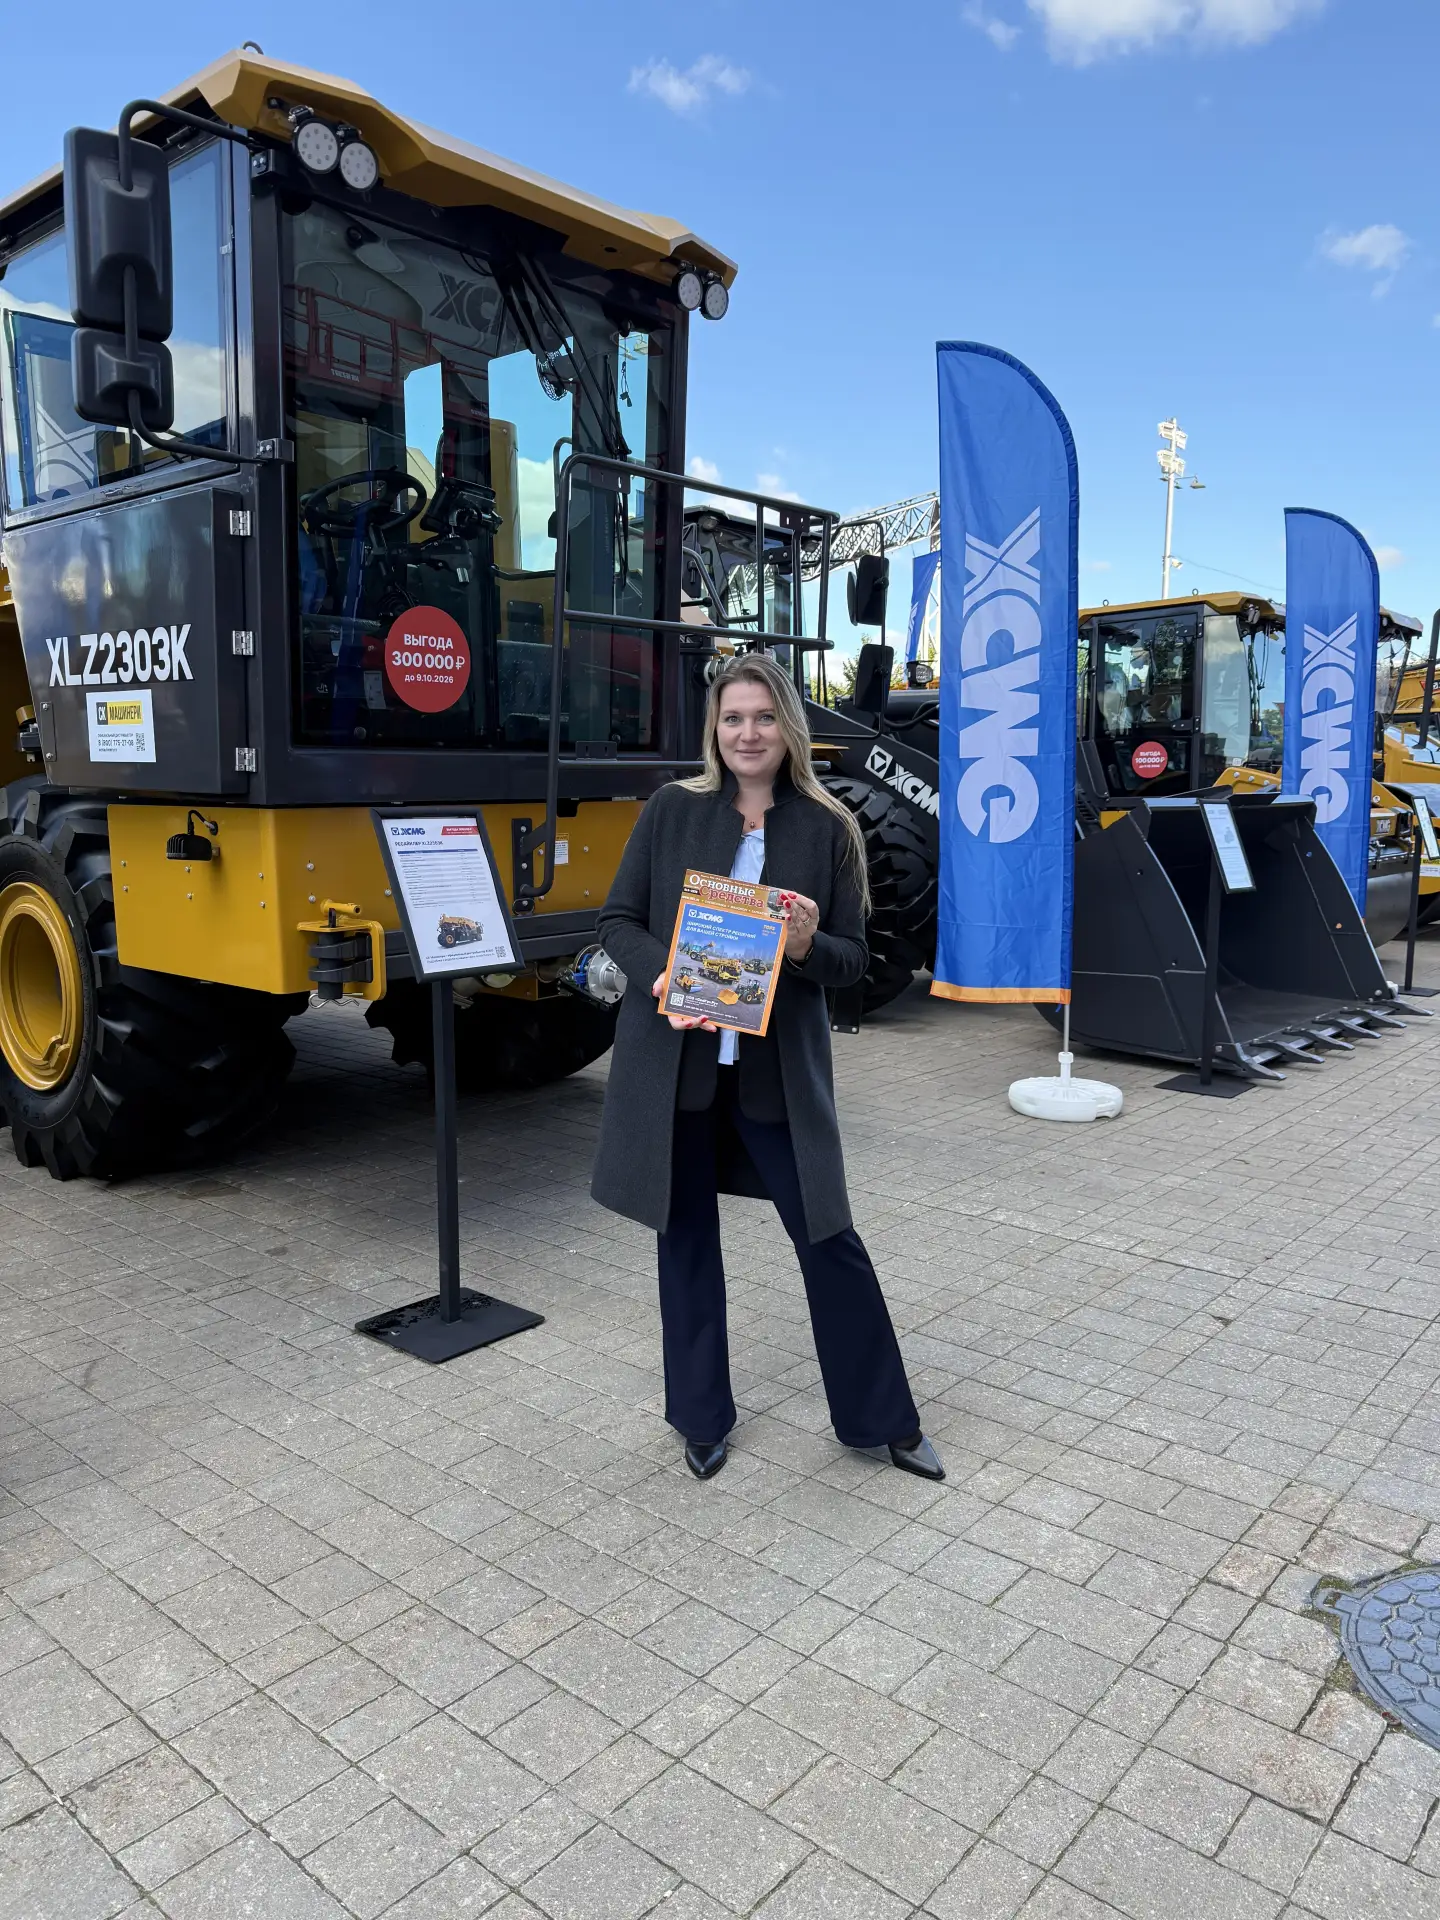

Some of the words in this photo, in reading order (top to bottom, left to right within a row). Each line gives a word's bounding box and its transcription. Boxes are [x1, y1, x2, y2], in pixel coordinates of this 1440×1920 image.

[403, 634, 454, 651] ВЫГОДА
[45, 623, 194, 687] XLZ2303K
[405, 674, 415, 682] до
[416, 674, 454, 684] 9.10.2026
[883, 763, 939, 820] XCM
[400, 827, 426, 836] XCMG
[689, 874, 755, 897] Основные
[699, 885, 764, 908] Средства
[697, 911, 724, 924] XCMG
